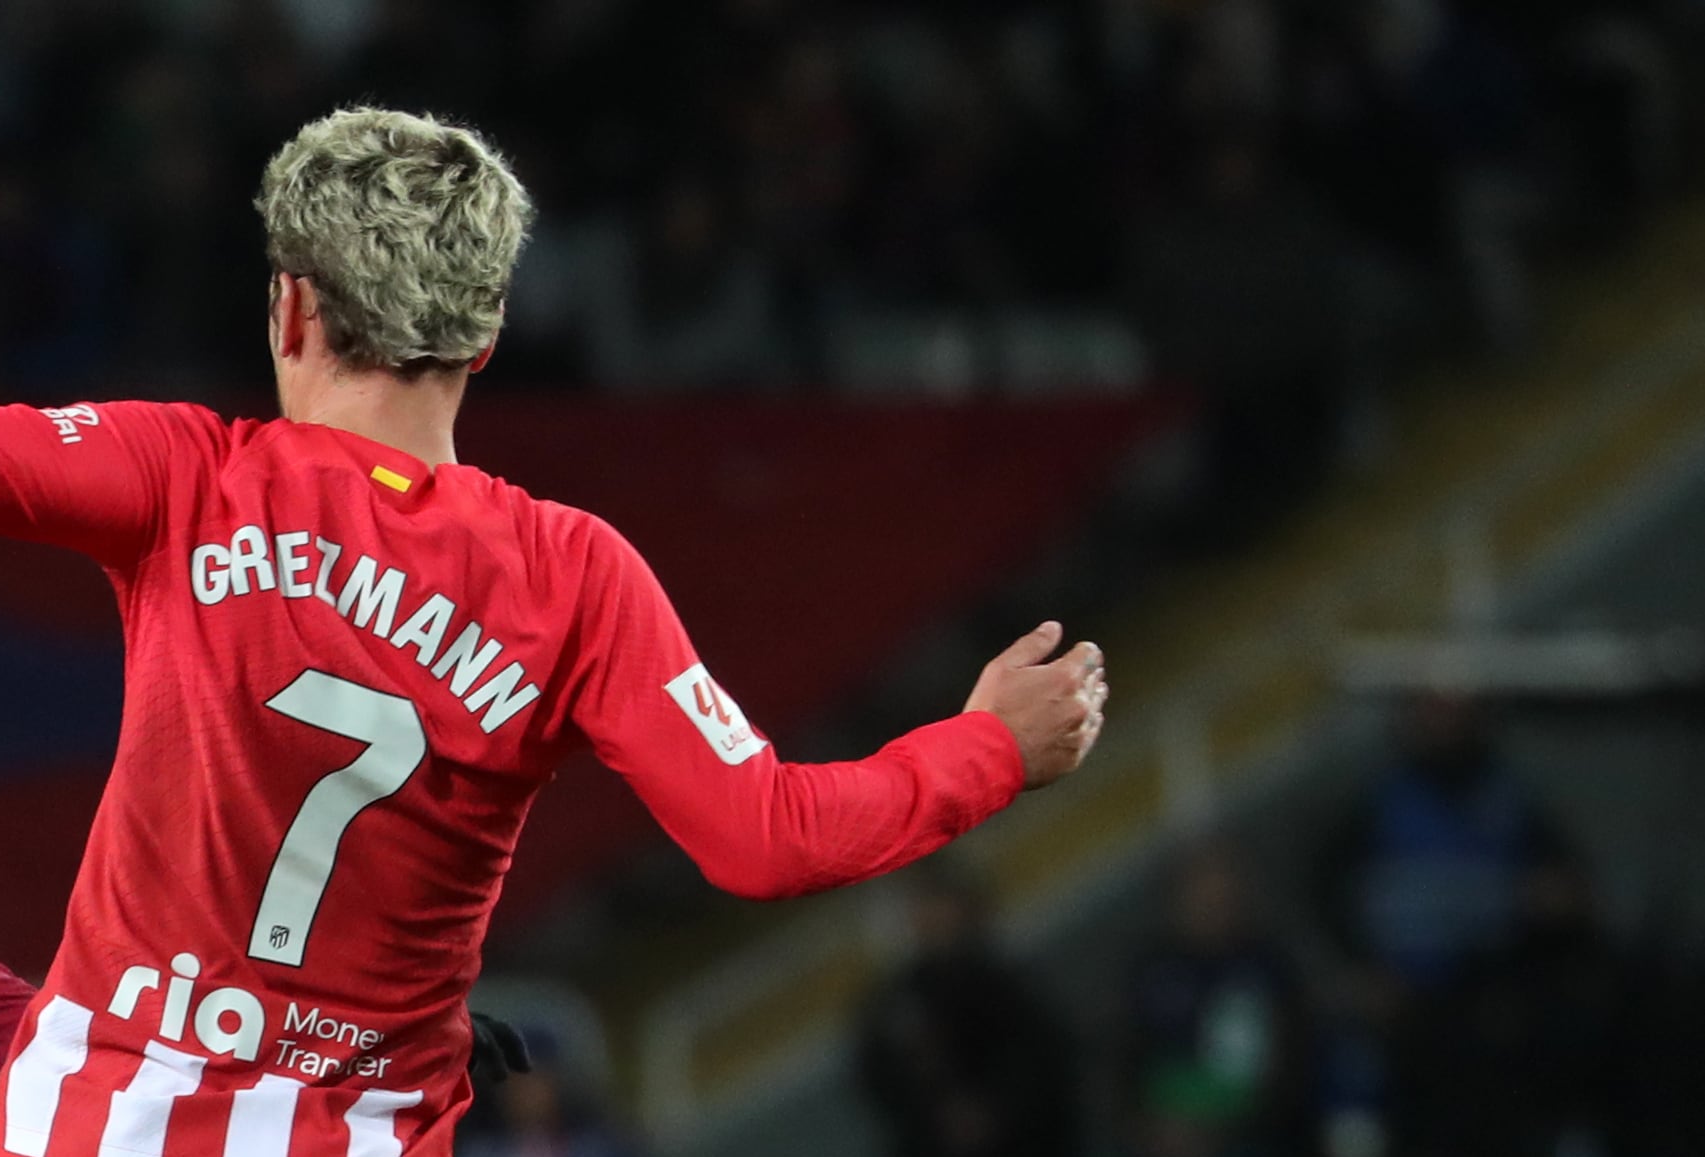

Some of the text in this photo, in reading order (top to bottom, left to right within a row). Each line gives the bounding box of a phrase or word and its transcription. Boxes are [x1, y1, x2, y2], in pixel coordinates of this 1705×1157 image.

[189, 524, 541, 735] GREZMANN
[247, 667, 428, 968] 7
[107, 952, 265, 1062] ria
[276, 1039, 392, 1079] Traner
[283, 1001, 384, 1051] Mone
